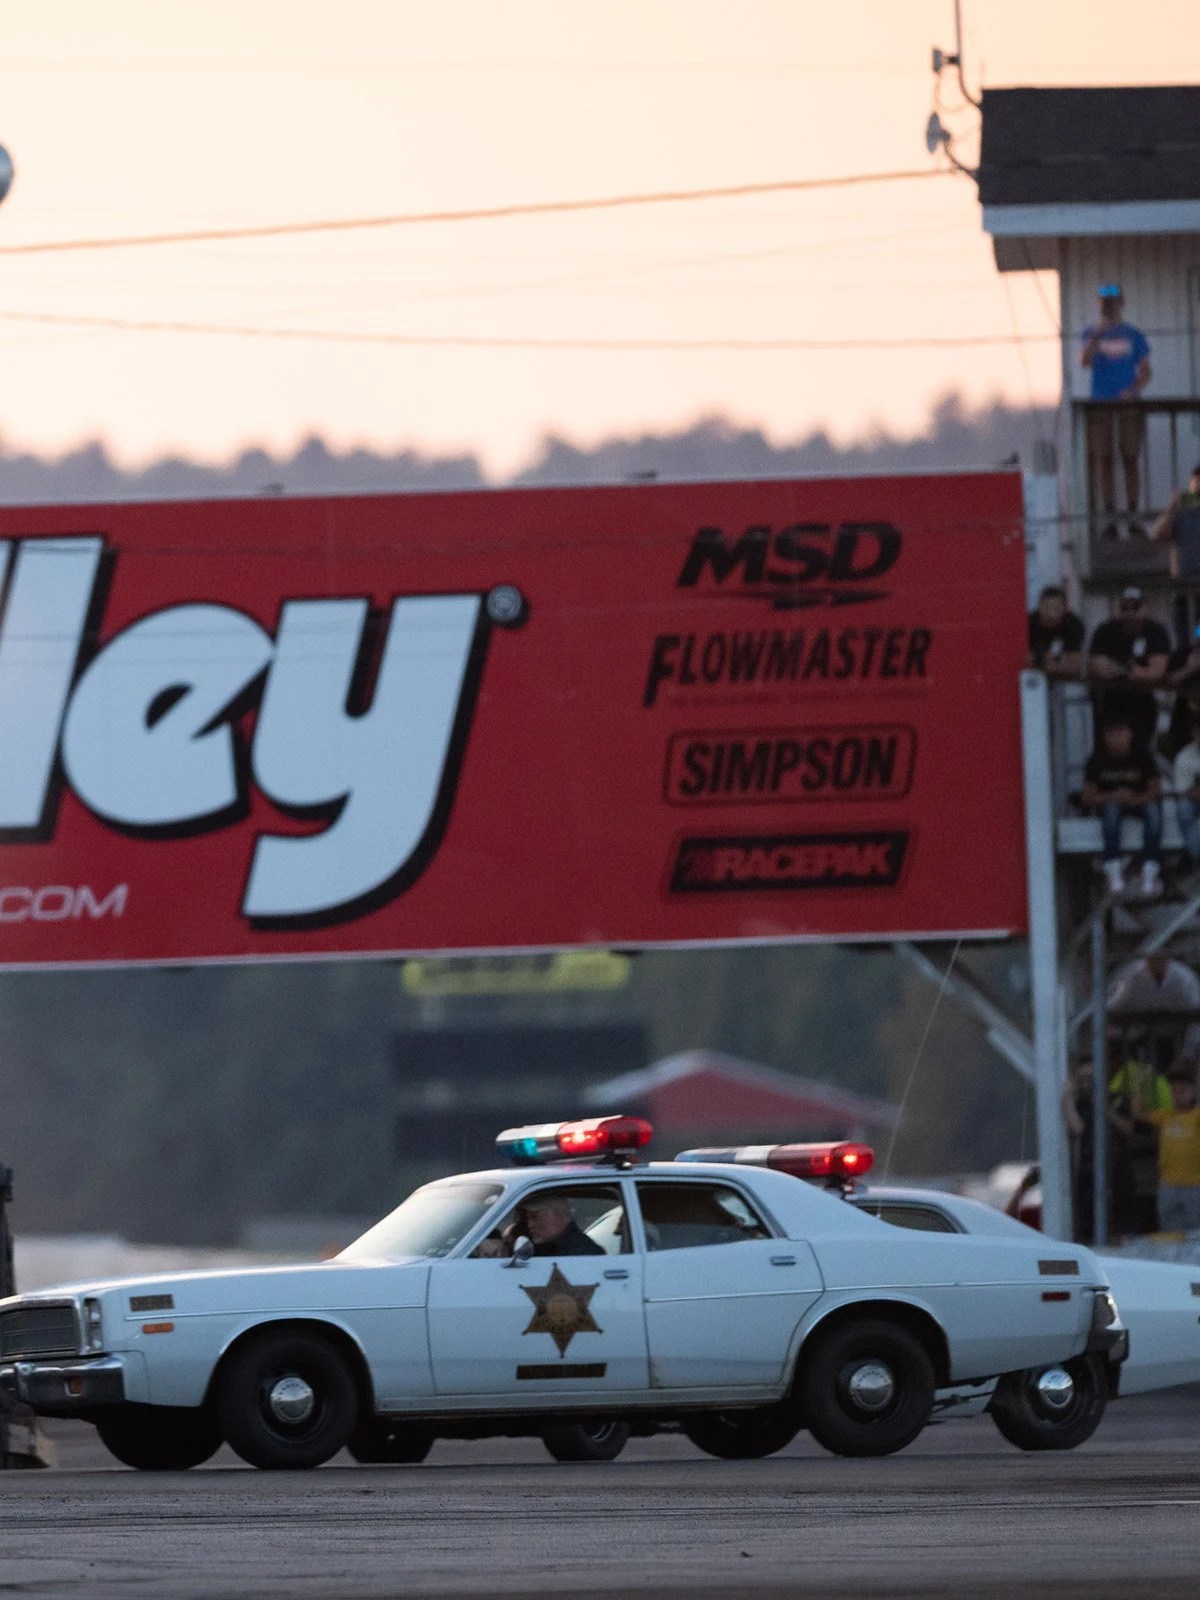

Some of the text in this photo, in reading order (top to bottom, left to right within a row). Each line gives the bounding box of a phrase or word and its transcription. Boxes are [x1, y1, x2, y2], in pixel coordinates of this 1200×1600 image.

[677, 522, 903, 588] MSD
[643, 626, 933, 708] FLOWMASTER
[679, 736, 898, 796] SIMPSON
[711, 842, 892, 881] RACEPAK
